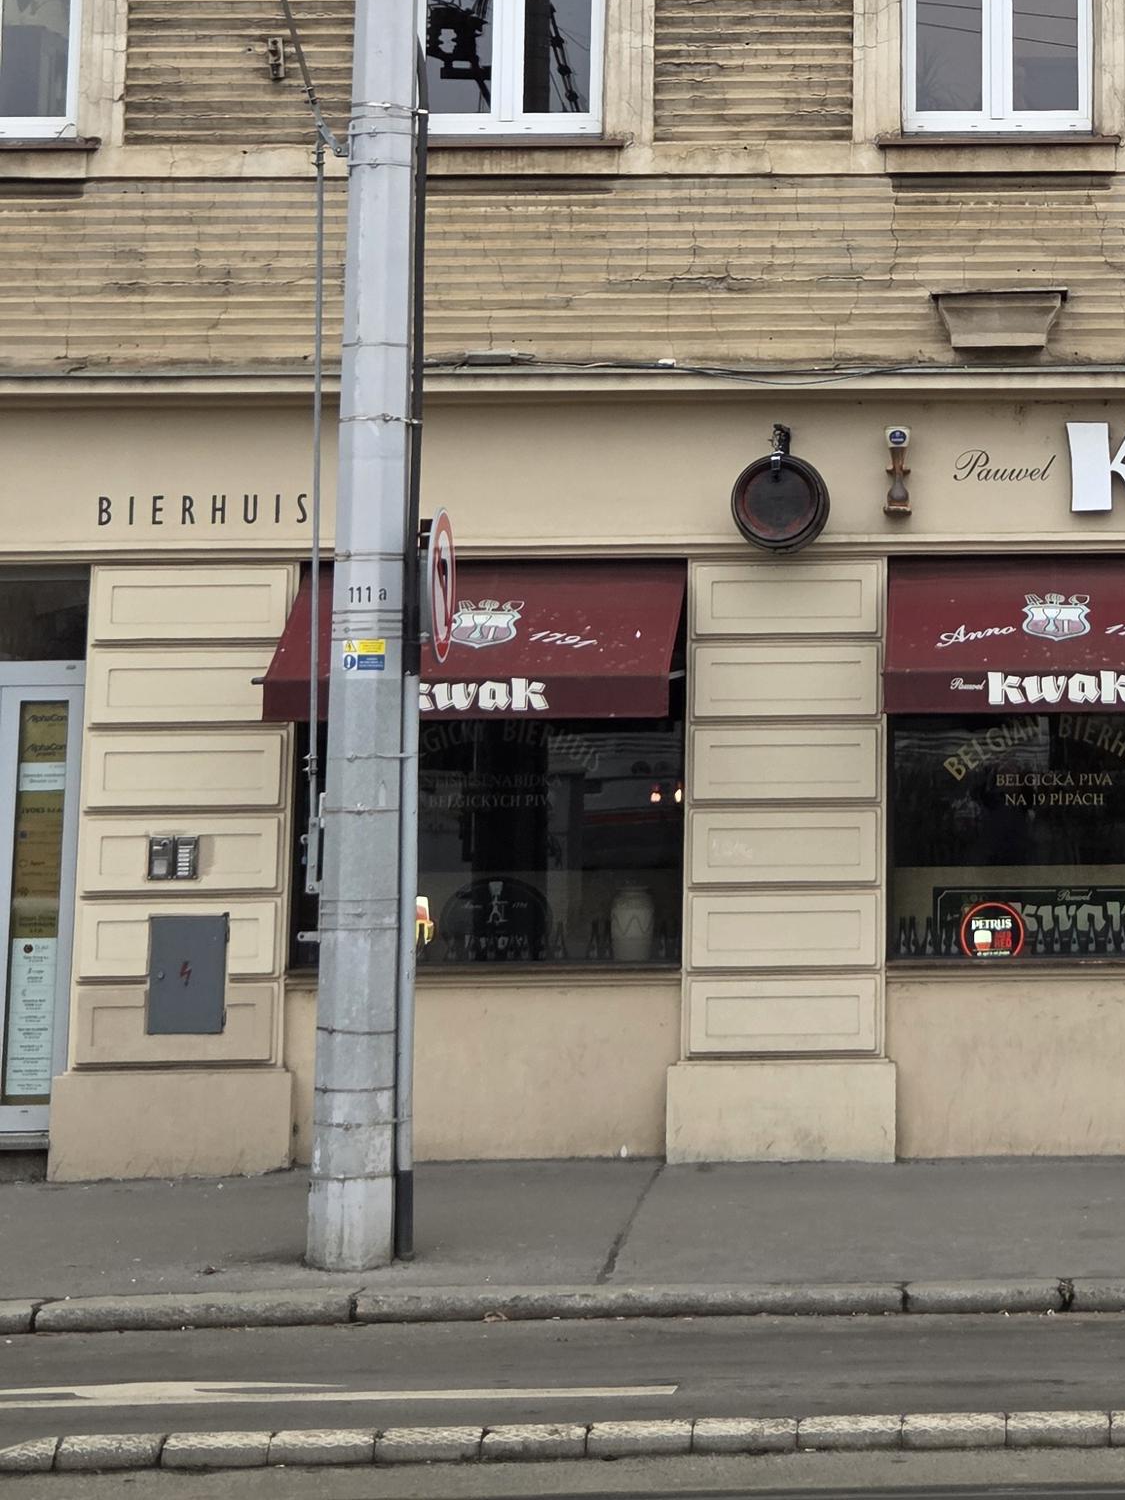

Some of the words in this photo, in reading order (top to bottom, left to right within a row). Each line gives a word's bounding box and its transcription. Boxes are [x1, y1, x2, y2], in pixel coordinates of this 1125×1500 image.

[953, 448, 1056, 483] Pauwel
[97, 493, 309, 526] BIERHUIS
[348, 585, 374, 604] 111
[378, 589, 388, 603] a
[529, 630, 597, 648] 1791
[935, 623, 1016, 648] Anno
[996, 770, 1075, 788] BELGICKÁ
[1078, 773, 1113, 787] PIVA
[1005, 794, 1027, 806] NA
[1033, 794, 1045, 806] 19
[971, 918, 1012, 930] PETRUS
